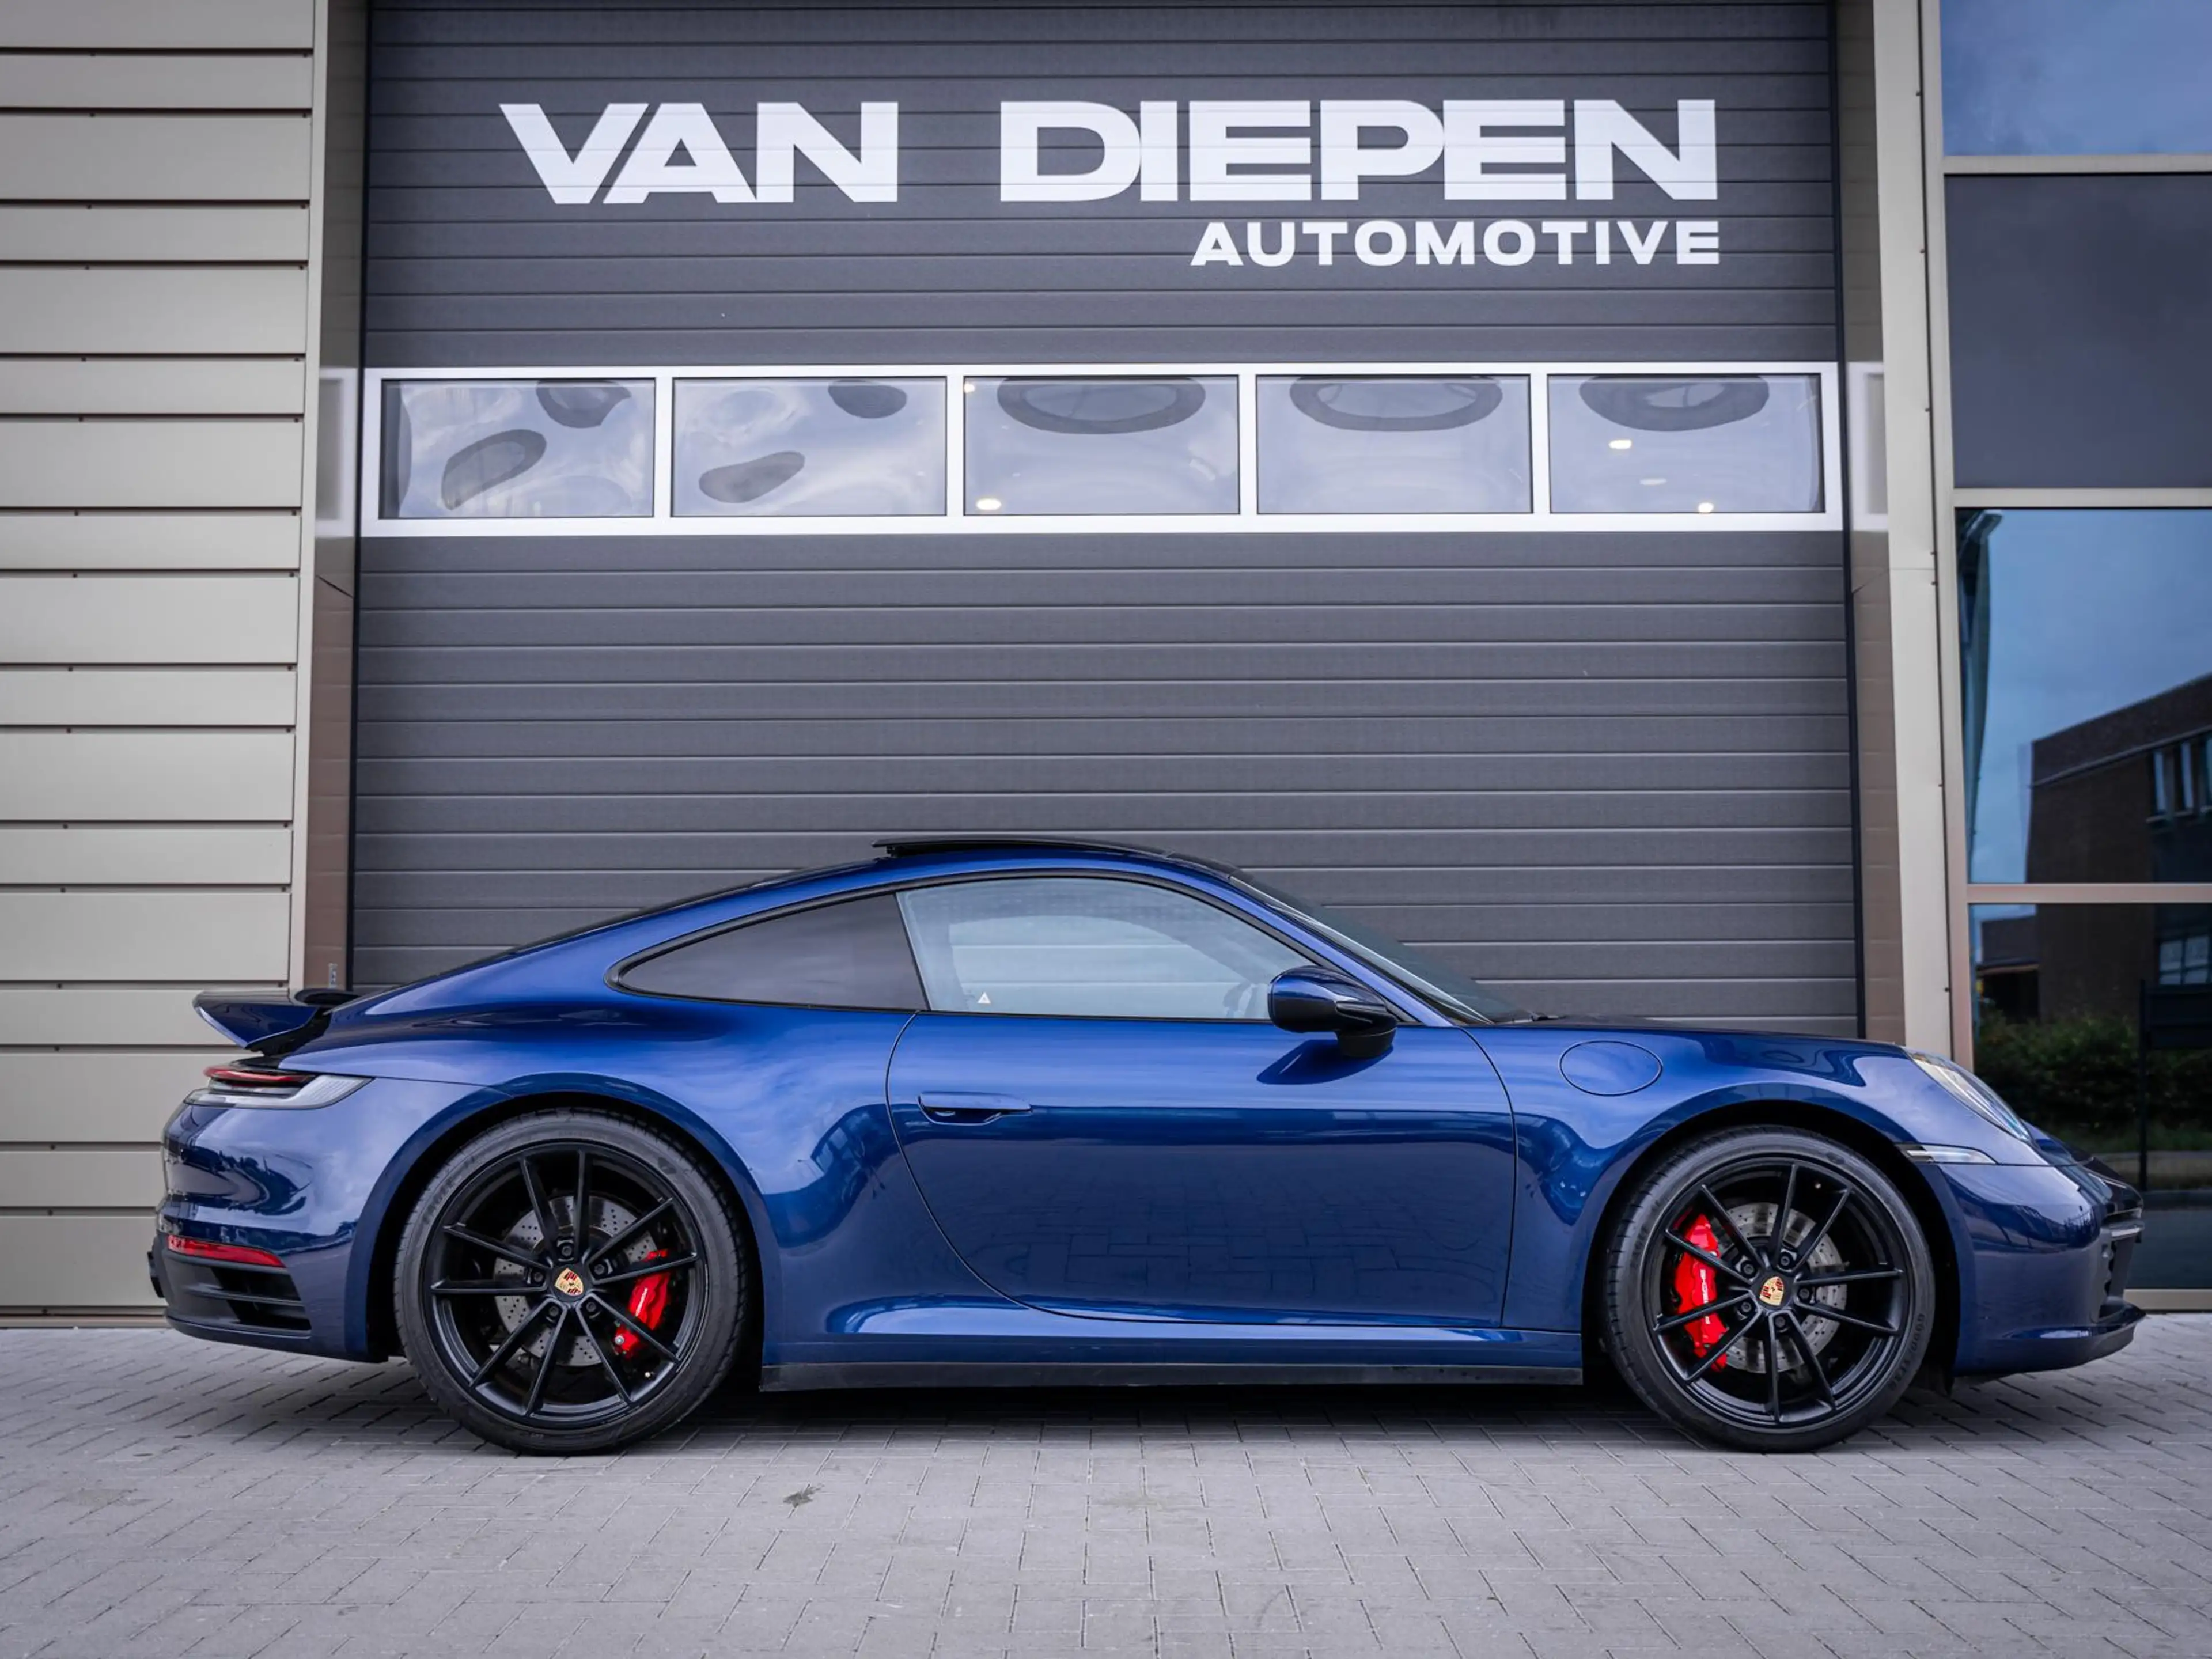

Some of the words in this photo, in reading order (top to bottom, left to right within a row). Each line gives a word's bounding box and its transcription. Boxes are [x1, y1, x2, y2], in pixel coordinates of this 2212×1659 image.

[500, 102, 898, 204] VAN
[1001, 100, 1717, 202] DIEPEN
[1191, 220, 1719, 266] AUTOMOTIVE
